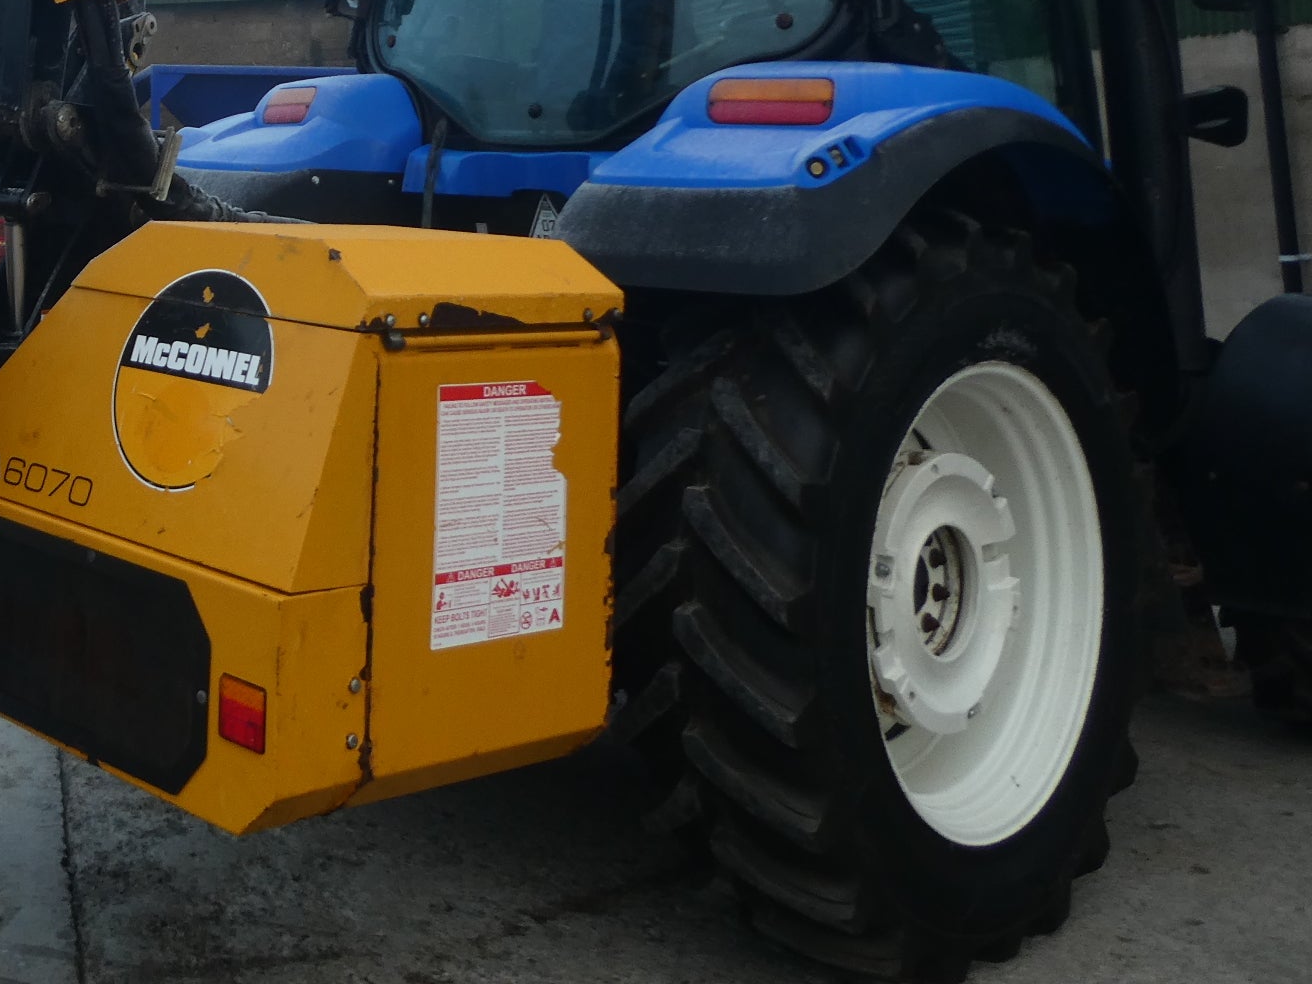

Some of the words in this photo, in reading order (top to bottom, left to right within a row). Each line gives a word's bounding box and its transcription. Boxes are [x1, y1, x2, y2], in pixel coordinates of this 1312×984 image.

[130, 334, 262, 386] McCONNEL
[483, 384, 527, 397] DANGER
[457, 566, 495, 581] DANGER
[510, 559, 546, 573] DANGER
